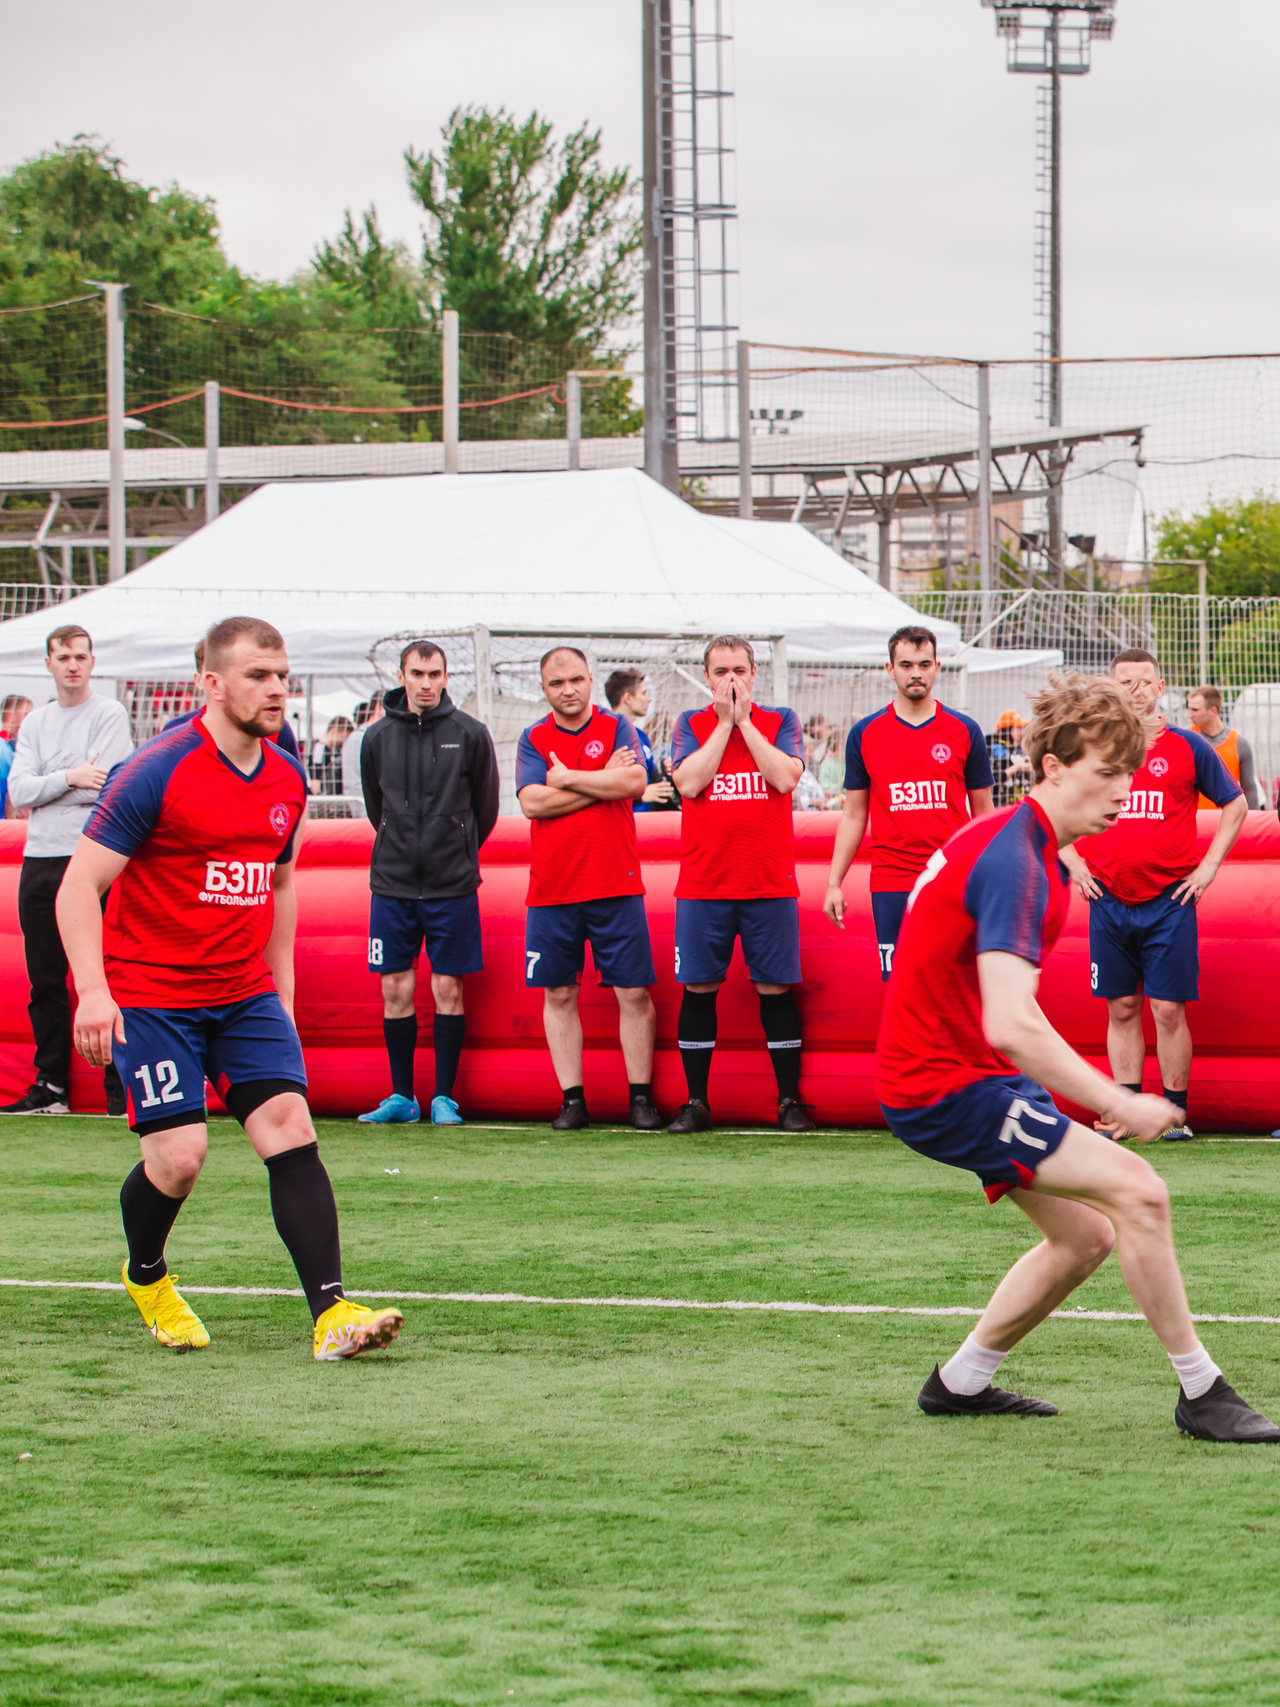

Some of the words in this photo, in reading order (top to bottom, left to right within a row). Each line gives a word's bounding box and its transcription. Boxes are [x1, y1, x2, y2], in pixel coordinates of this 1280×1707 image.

[713, 771, 767, 794] БЗПП
[888, 780, 947, 804] БЗПП
[134, 1060, 184, 1108] 12
[998, 1098, 1058, 1151] 77
